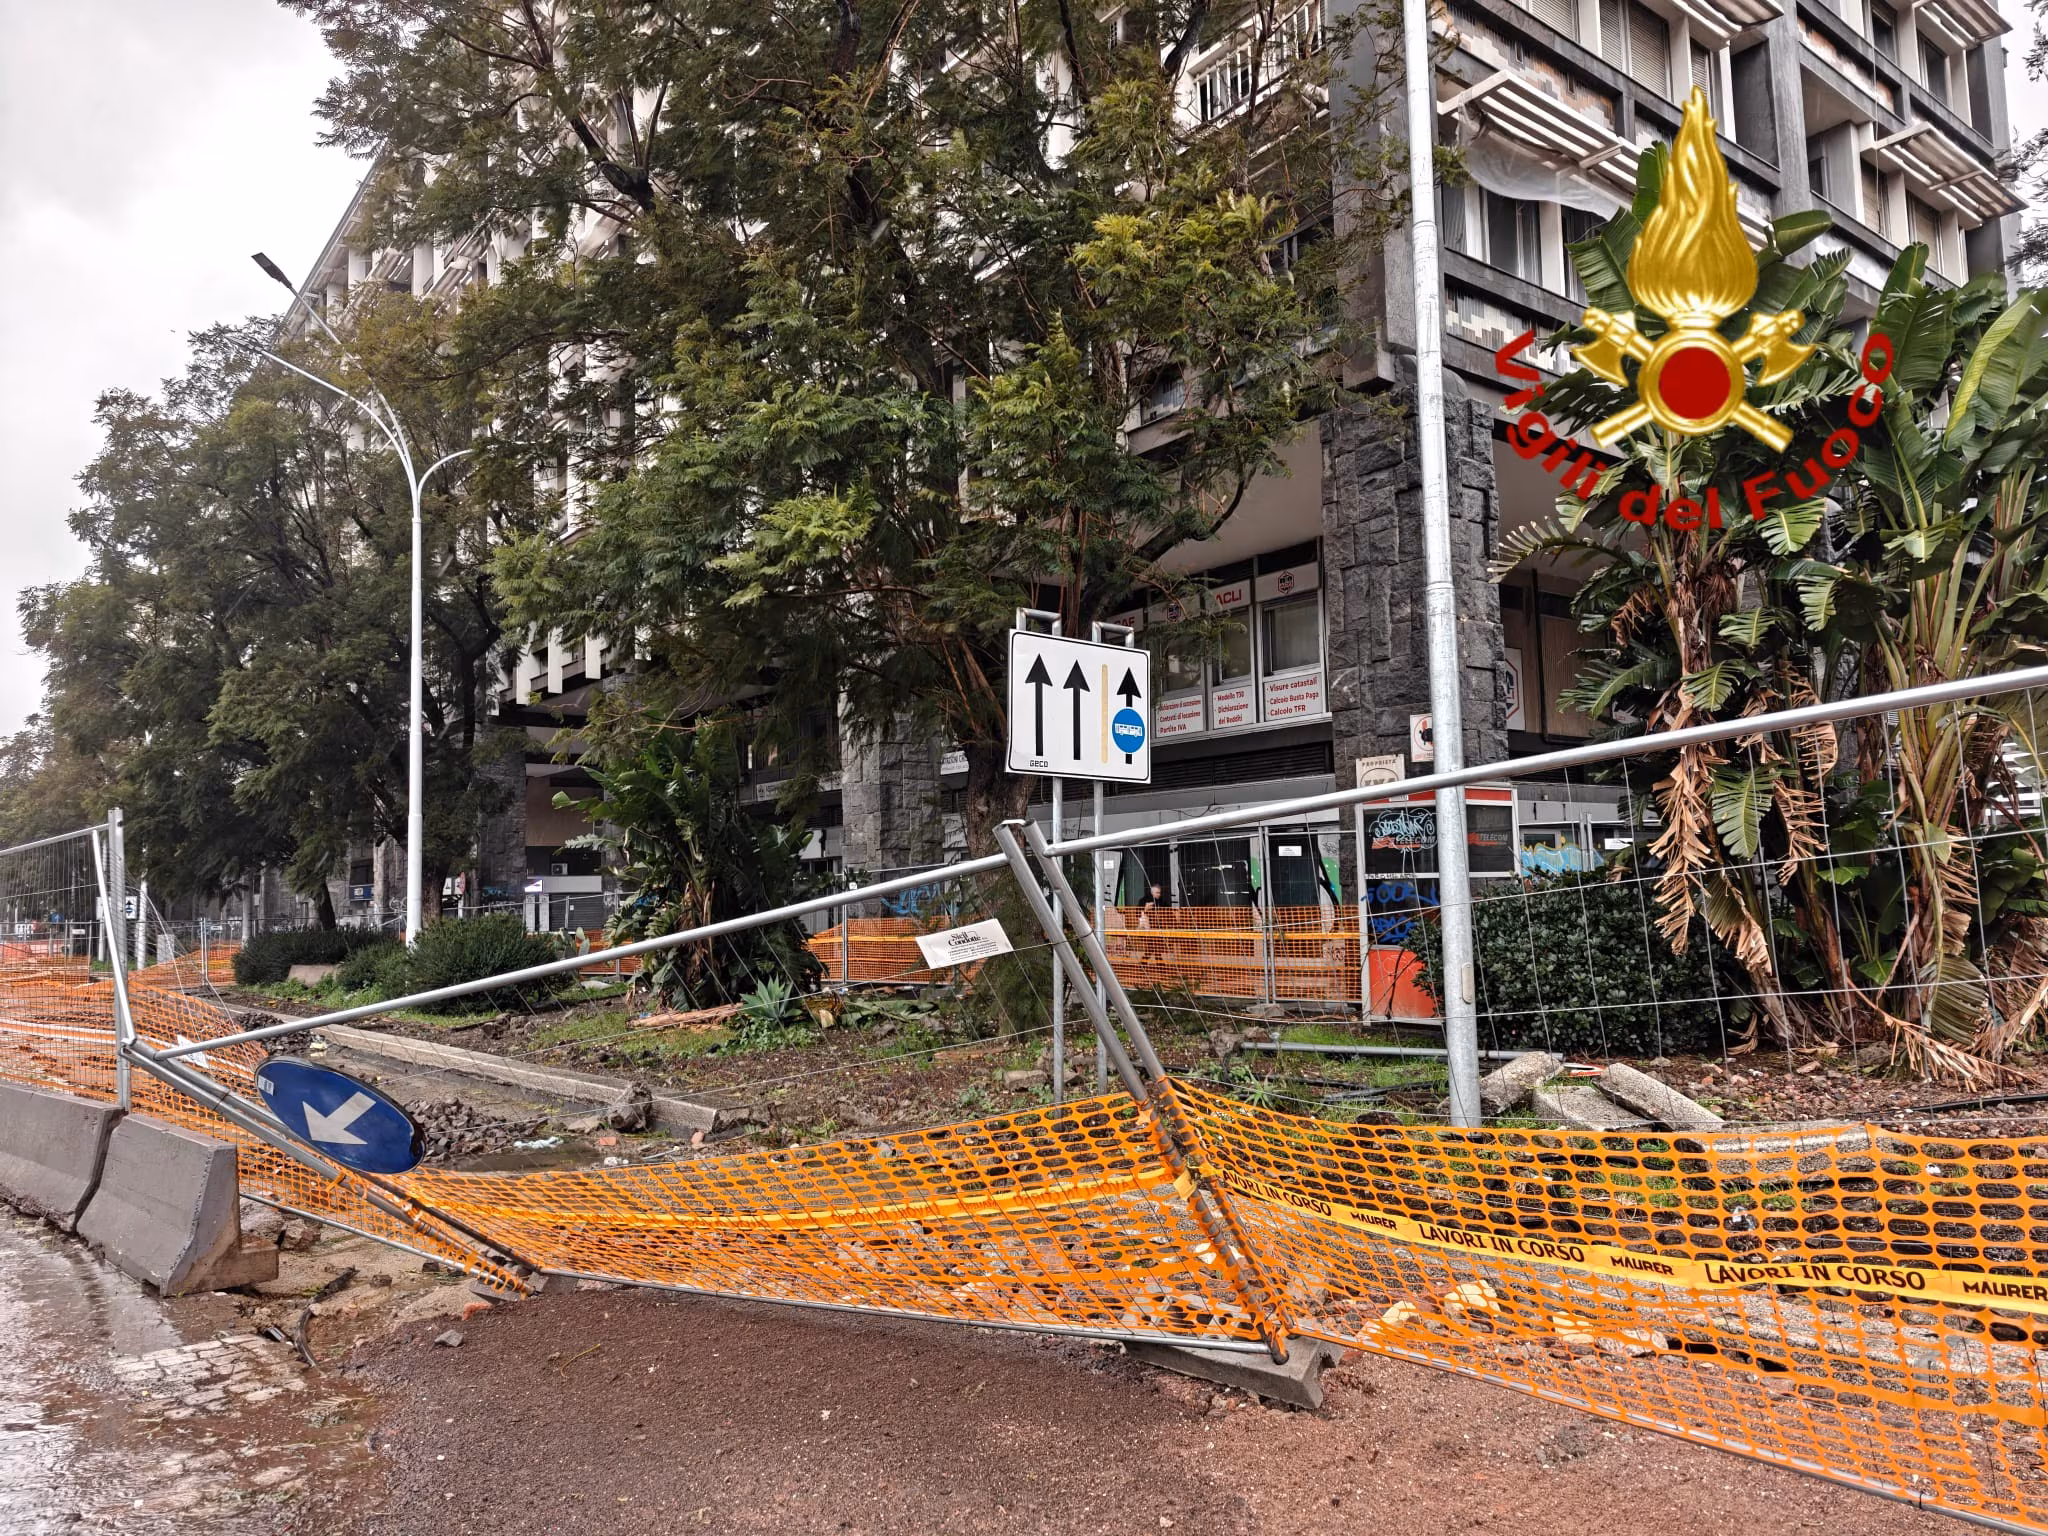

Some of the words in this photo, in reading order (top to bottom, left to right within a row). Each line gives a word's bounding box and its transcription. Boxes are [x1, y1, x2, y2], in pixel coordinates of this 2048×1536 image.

[1270, 684, 1289, 692] Visure
[1270, 696, 1289, 705] Calcolo
[1305, 692, 1319, 701] Paga
[1270, 706, 1293, 716] Calcolo
[1294, 704, 1307, 713] TFR
[1178, 723, 1187, 731] IVA
[1222, 1169, 1262, 1195] AVORI
[1265, 1183, 1283, 1201] IN
[1283, 1191, 1332, 1217] CORSO
[1350, 1212, 1398, 1231] MAURER
[1418, 1223, 1485, 1249] LAVORI
[1491, 1235, 1515, 1254] IN
[1517, 1239, 1586, 1263] CORSO
[1610, 1255, 1675, 1276] MAURER
[1704, 1262, 1796, 1284] LAVORI
[1802, 1264, 1831, 1281] IN
[1837, 1265, 1927, 1291] CORSO
[1962, 1280, 2048, 1301] MAURER
